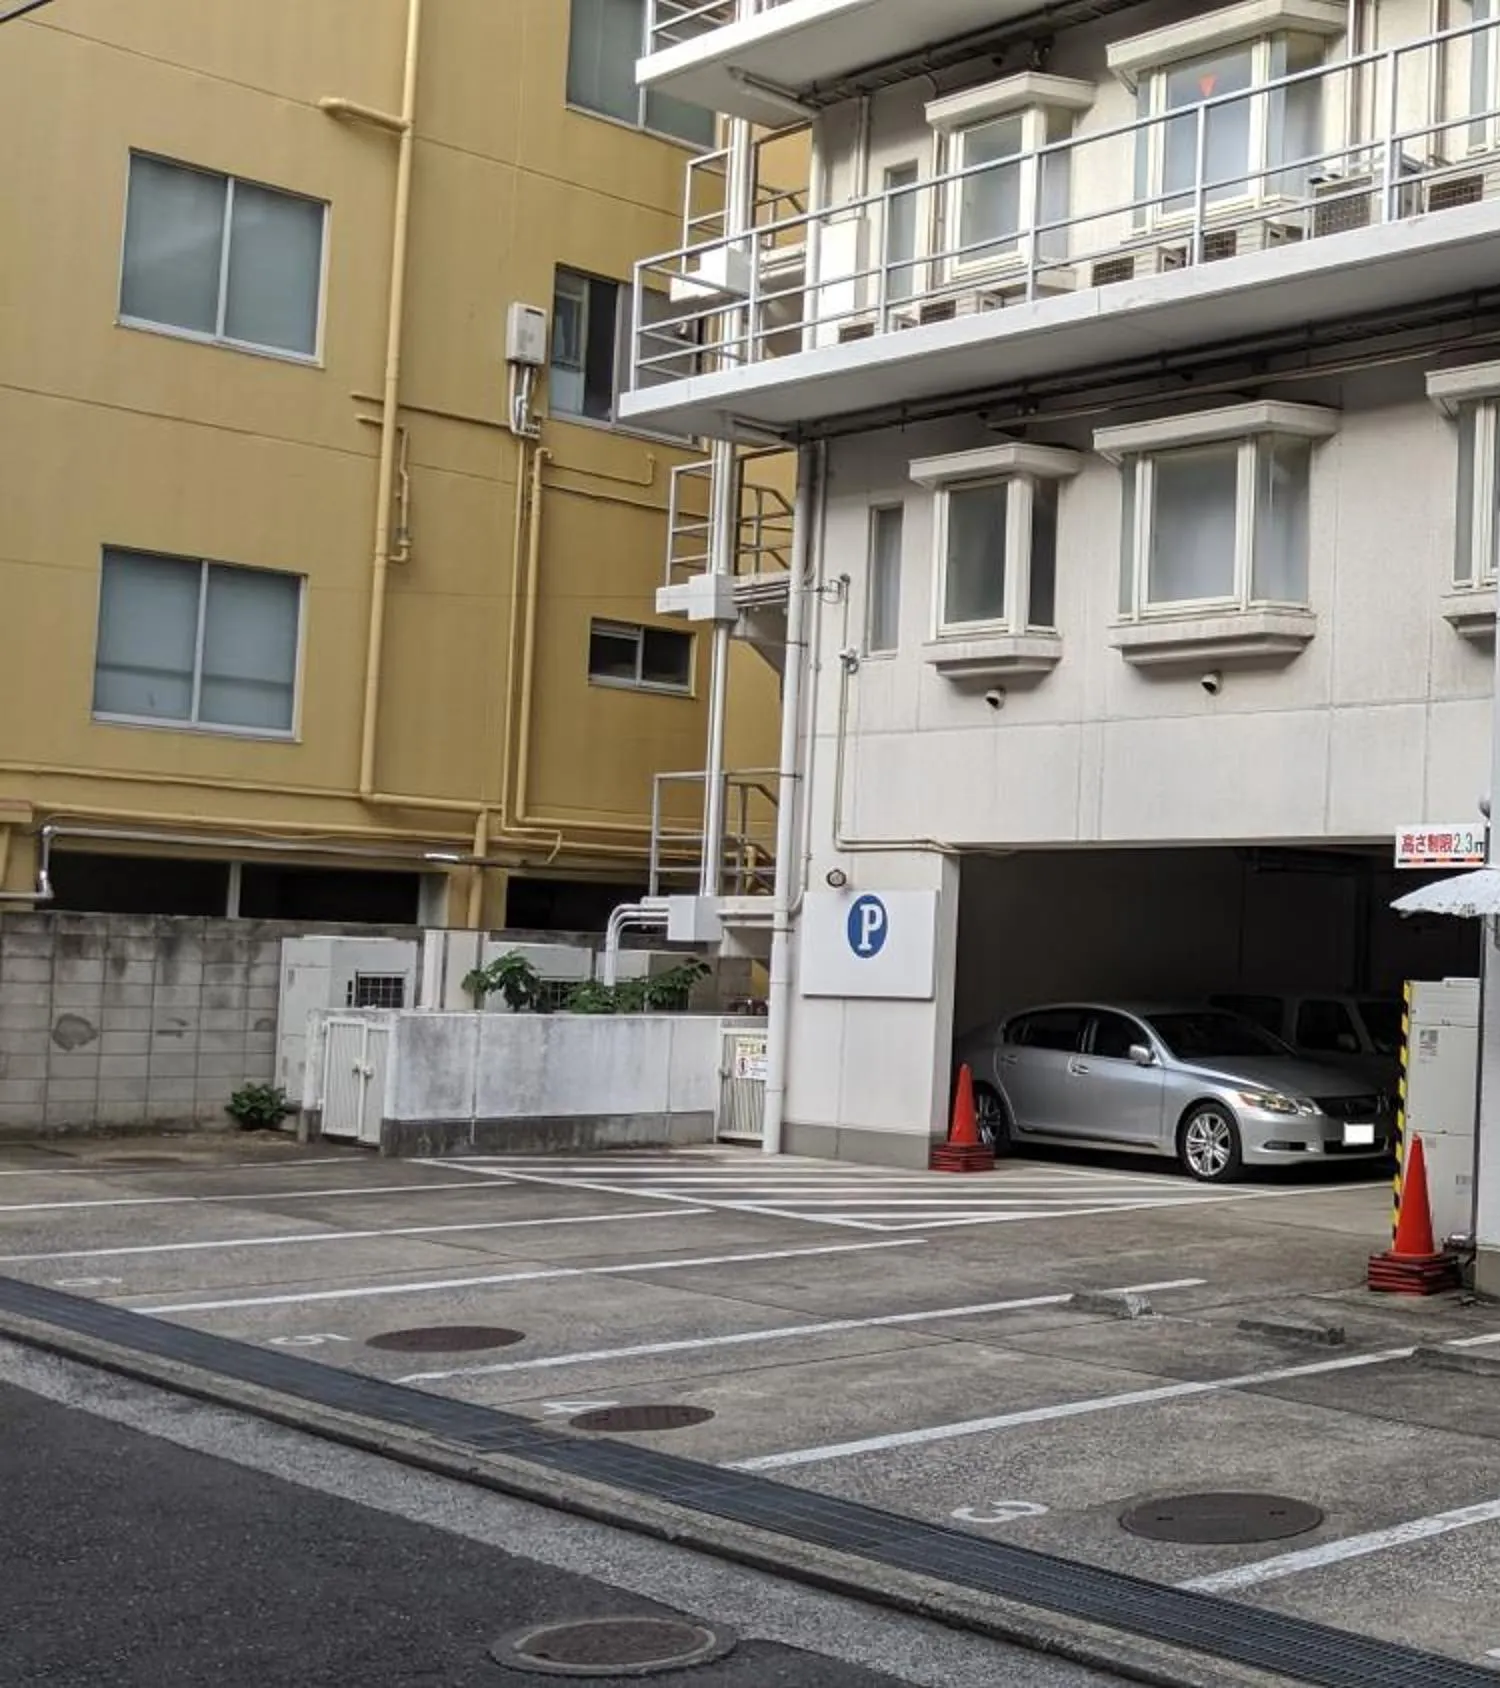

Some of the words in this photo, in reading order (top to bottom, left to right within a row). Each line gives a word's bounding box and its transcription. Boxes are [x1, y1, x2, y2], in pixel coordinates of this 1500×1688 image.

[857, 903, 883, 950] P
[267, 1333, 351, 1347] 5
[950, 1501, 1049, 1522] 3
